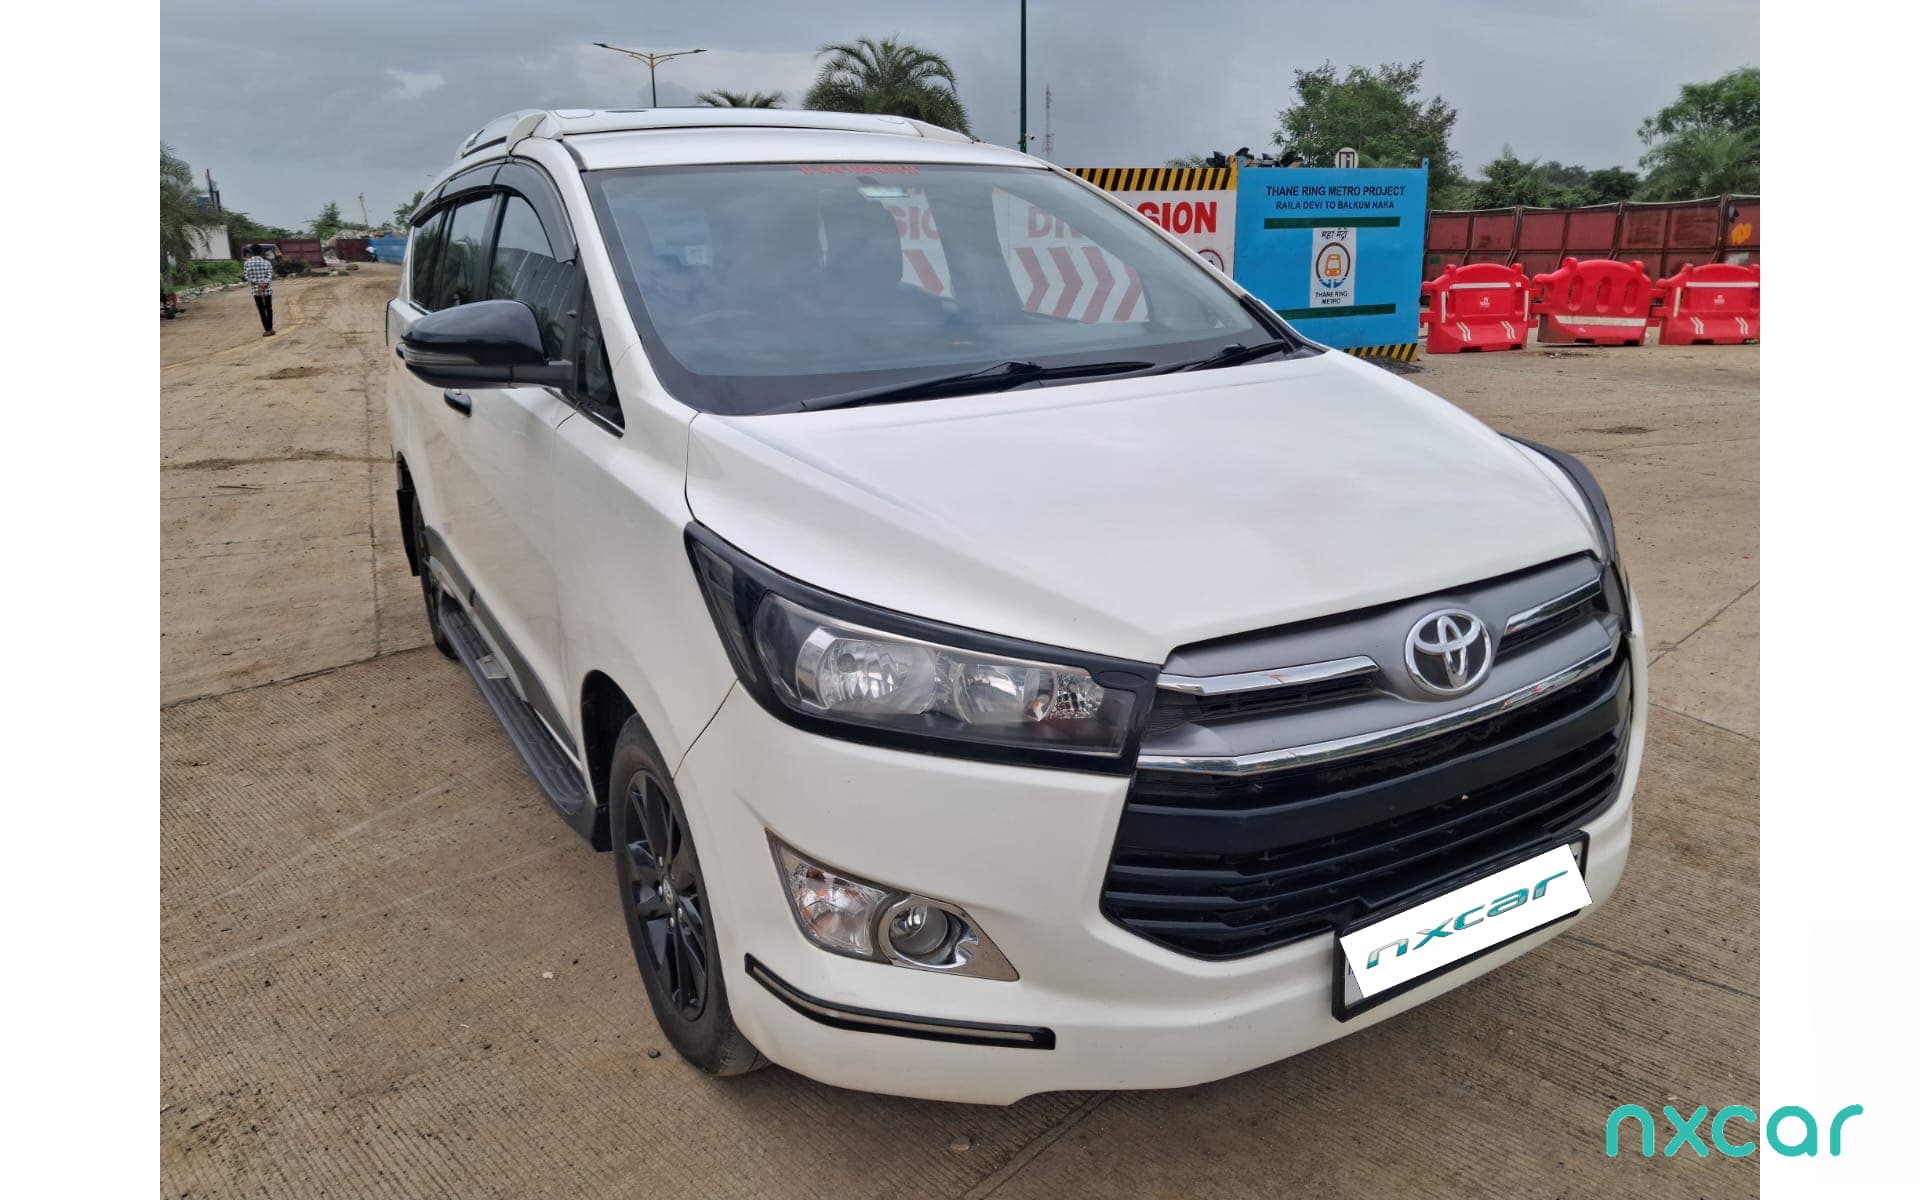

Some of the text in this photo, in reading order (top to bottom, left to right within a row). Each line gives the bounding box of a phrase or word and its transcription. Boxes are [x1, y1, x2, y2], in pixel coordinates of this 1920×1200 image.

[1266, 186, 1406, 197] THANE RING METRO PROJECT
[1276, 201, 1395, 210] RAILA DEVI TO BALKUM NAKA
